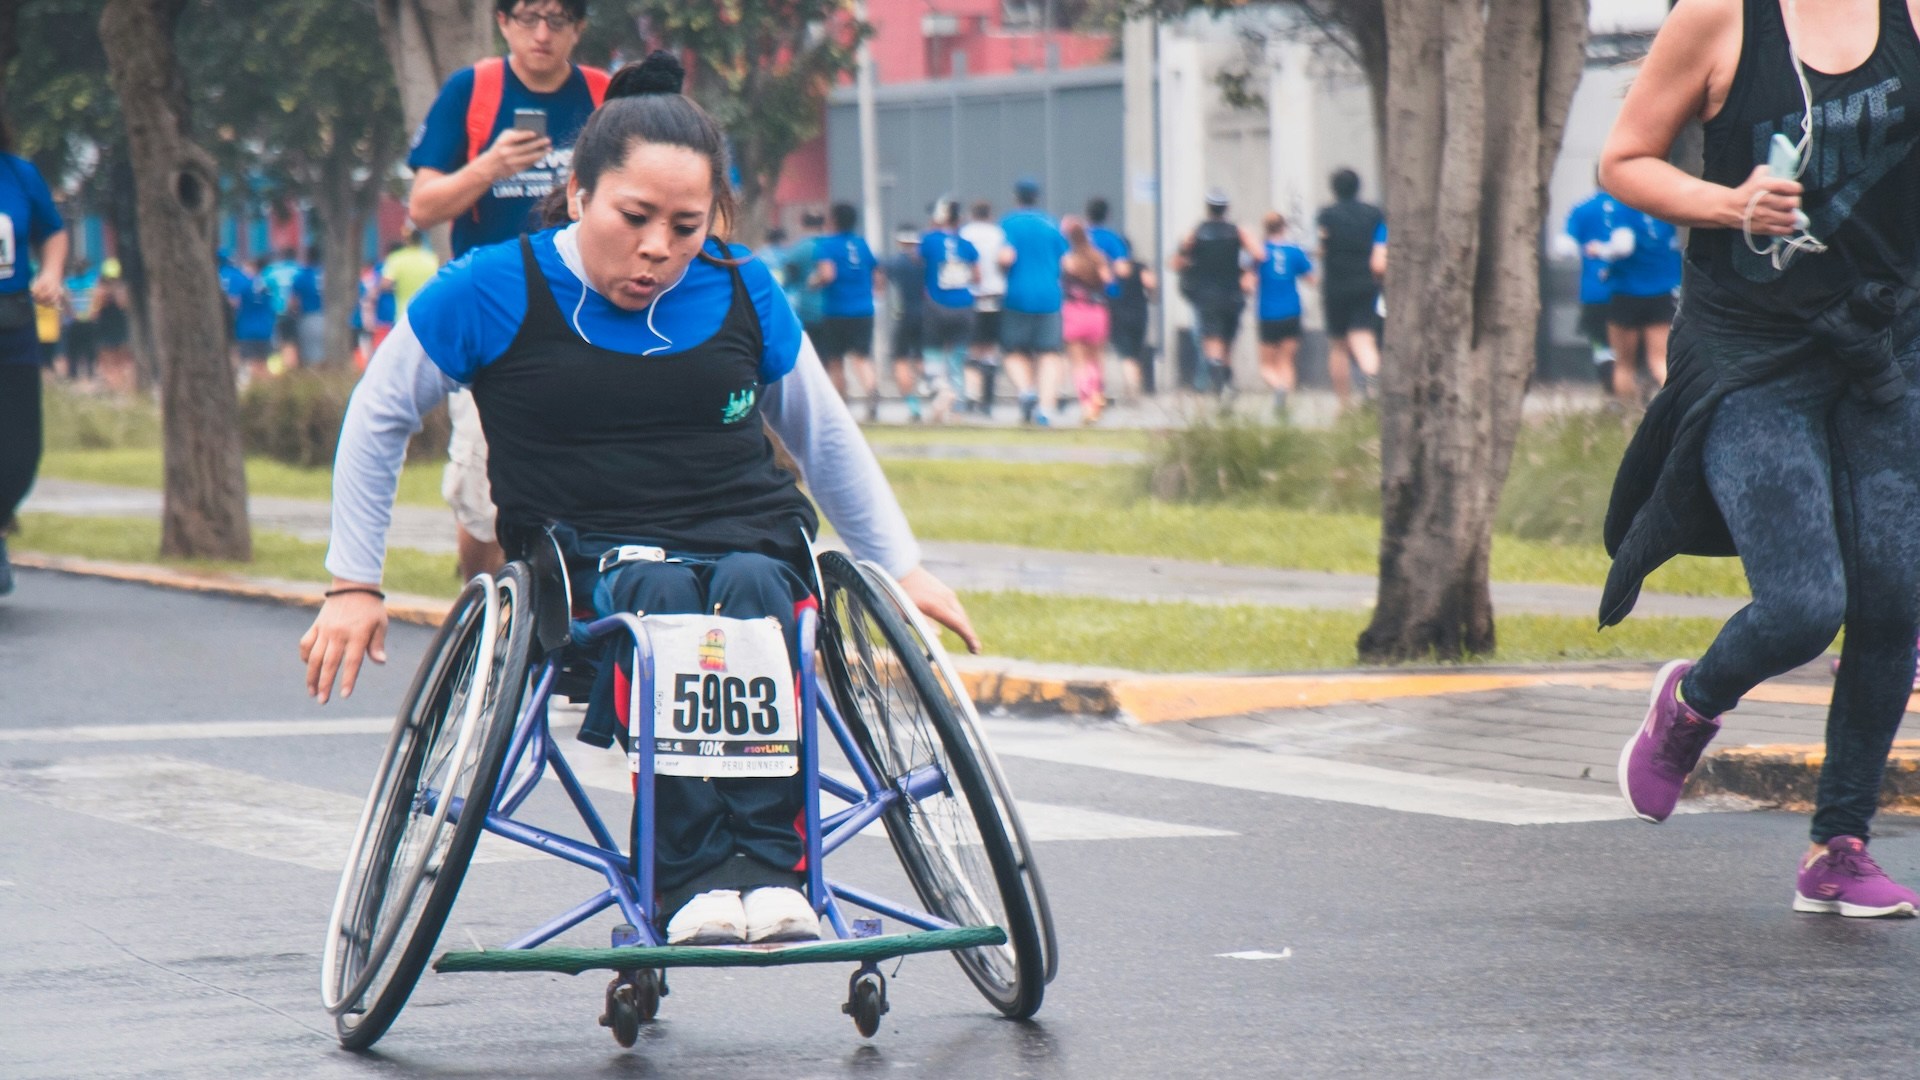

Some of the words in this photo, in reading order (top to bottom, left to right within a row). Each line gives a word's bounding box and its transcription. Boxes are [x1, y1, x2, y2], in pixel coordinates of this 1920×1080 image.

[673, 673, 780, 736] 5963
[698, 741, 725, 756] 10K
[722, 760, 743, 771] PERU
[746, 760, 784, 770] RUNNERS
